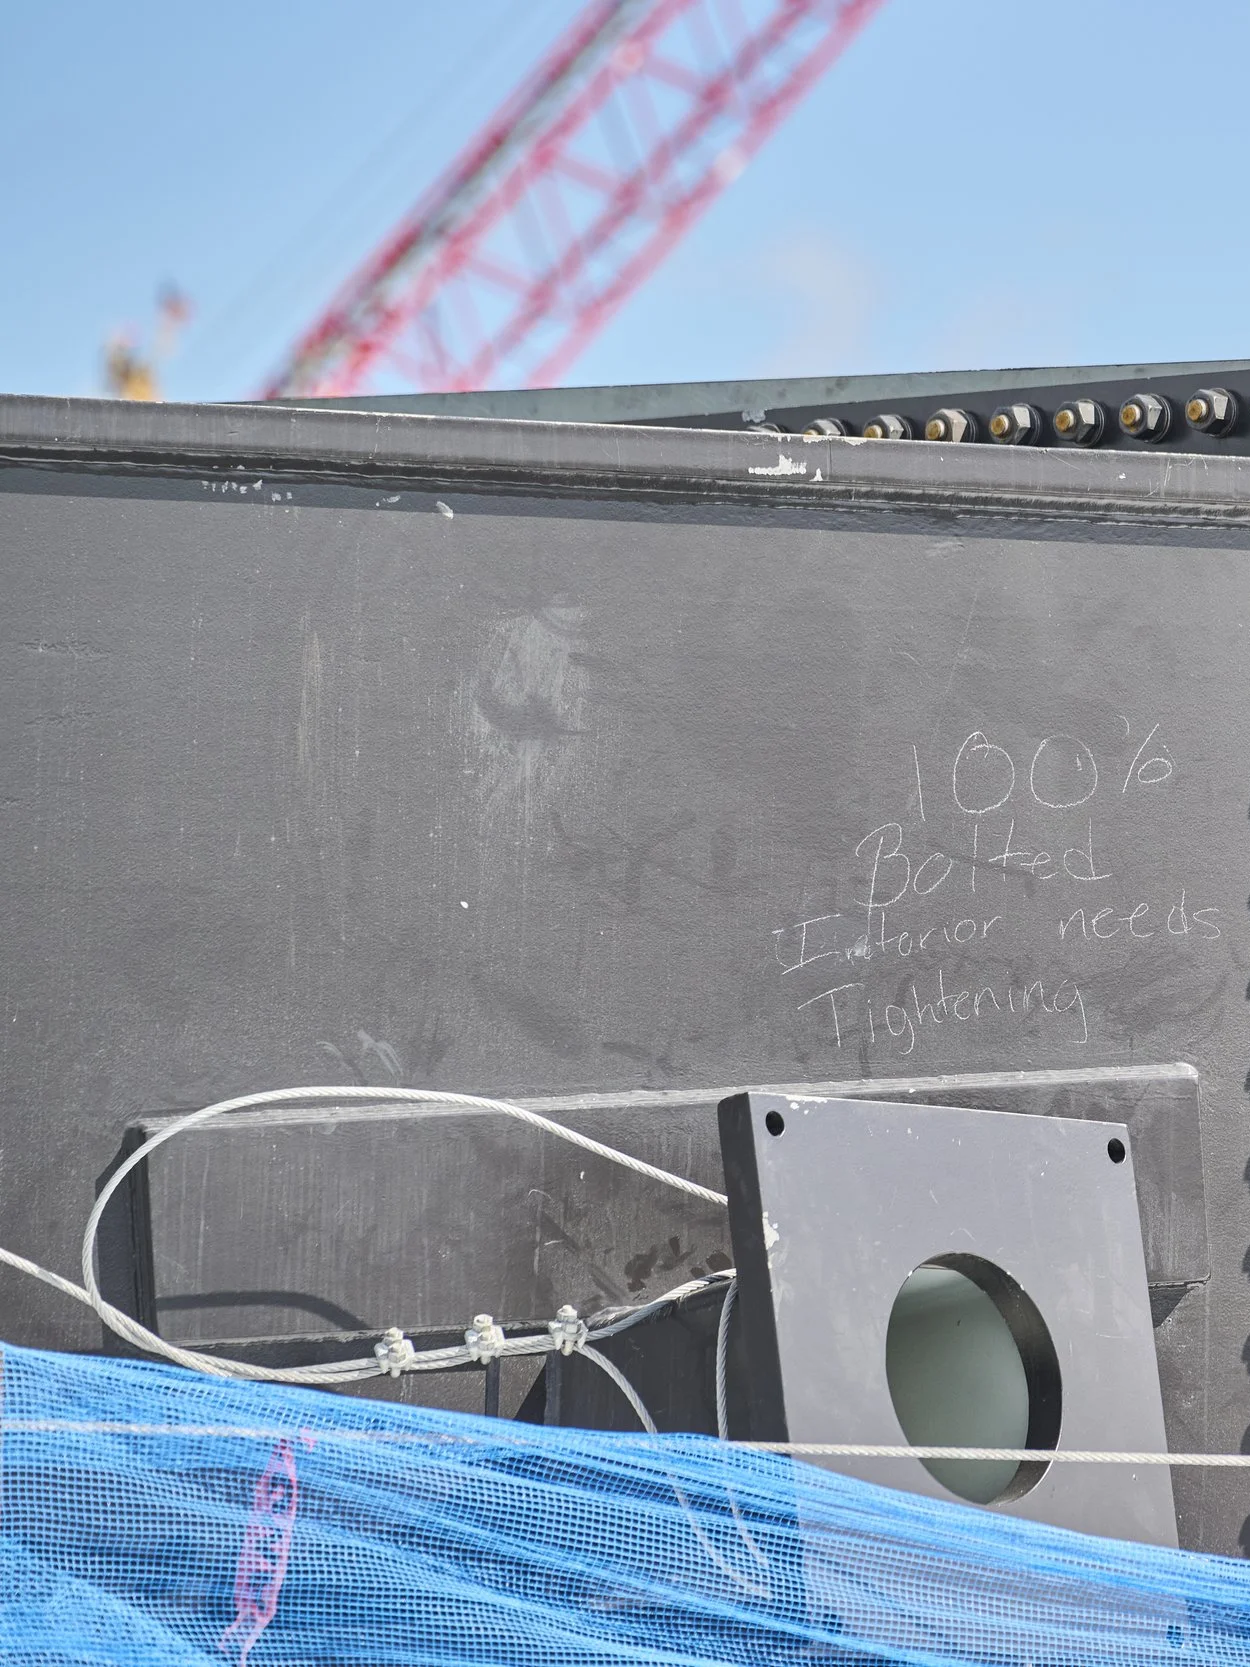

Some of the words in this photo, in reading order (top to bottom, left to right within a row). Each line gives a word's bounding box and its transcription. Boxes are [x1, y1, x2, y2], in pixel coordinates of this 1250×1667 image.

[911, 715, 1175, 822] 100%
[854, 817, 1113, 930] Bolted
[1058, 888, 1221, 939] needs
[797, 968, 1088, 1055] Tightening
